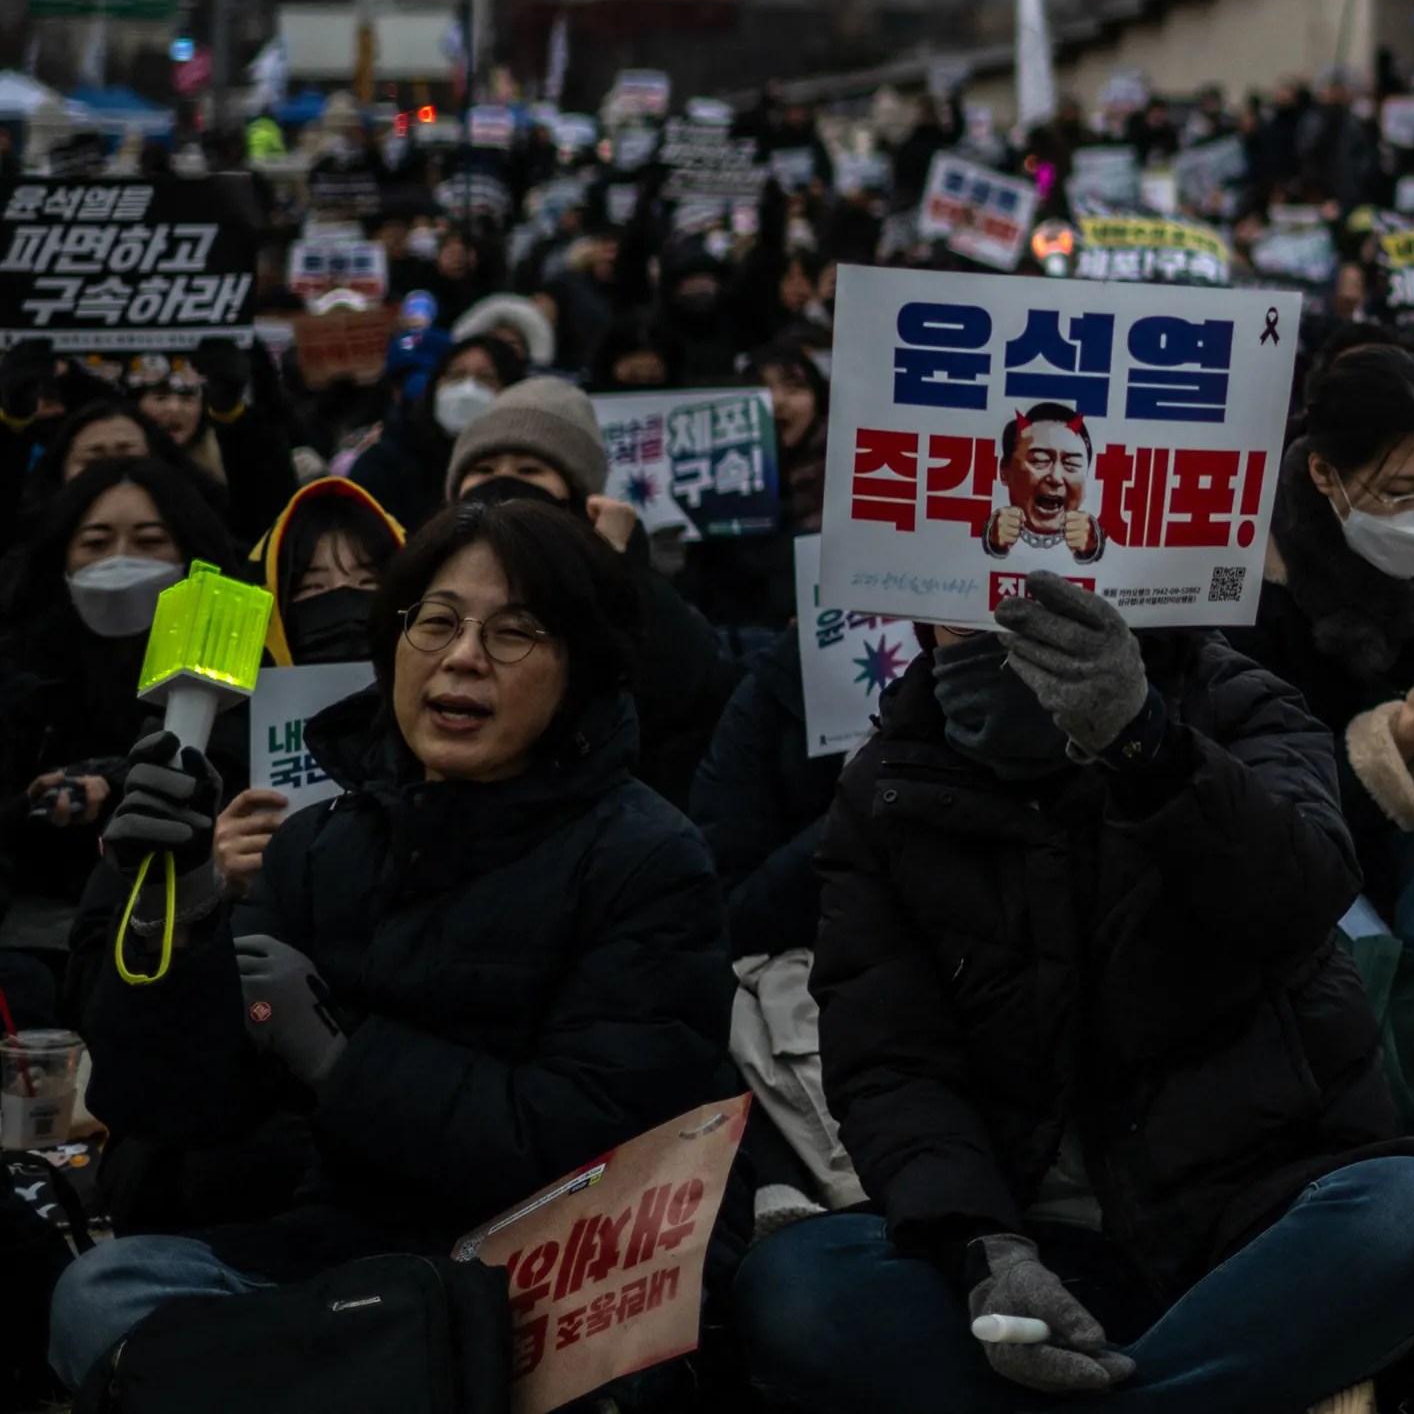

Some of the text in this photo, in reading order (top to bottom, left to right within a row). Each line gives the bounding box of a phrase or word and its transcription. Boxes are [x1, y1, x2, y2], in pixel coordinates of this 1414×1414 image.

[3, 185, 154, 222] 윤석열을
[0, 221, 220, 274] 파면하고
[20, 272, 254, 326] 구속하라!
[893, 301, 1235, 423] 윤석열
[672, 399, 760, 460] 체포!
[673, 447, 764, 509] 구속!
[851, 427, 1267, 549] 즉각 체포!
[507, 1178, 705, 1316] 해체하
[555, 1266, 681, 1351] 내란동조
